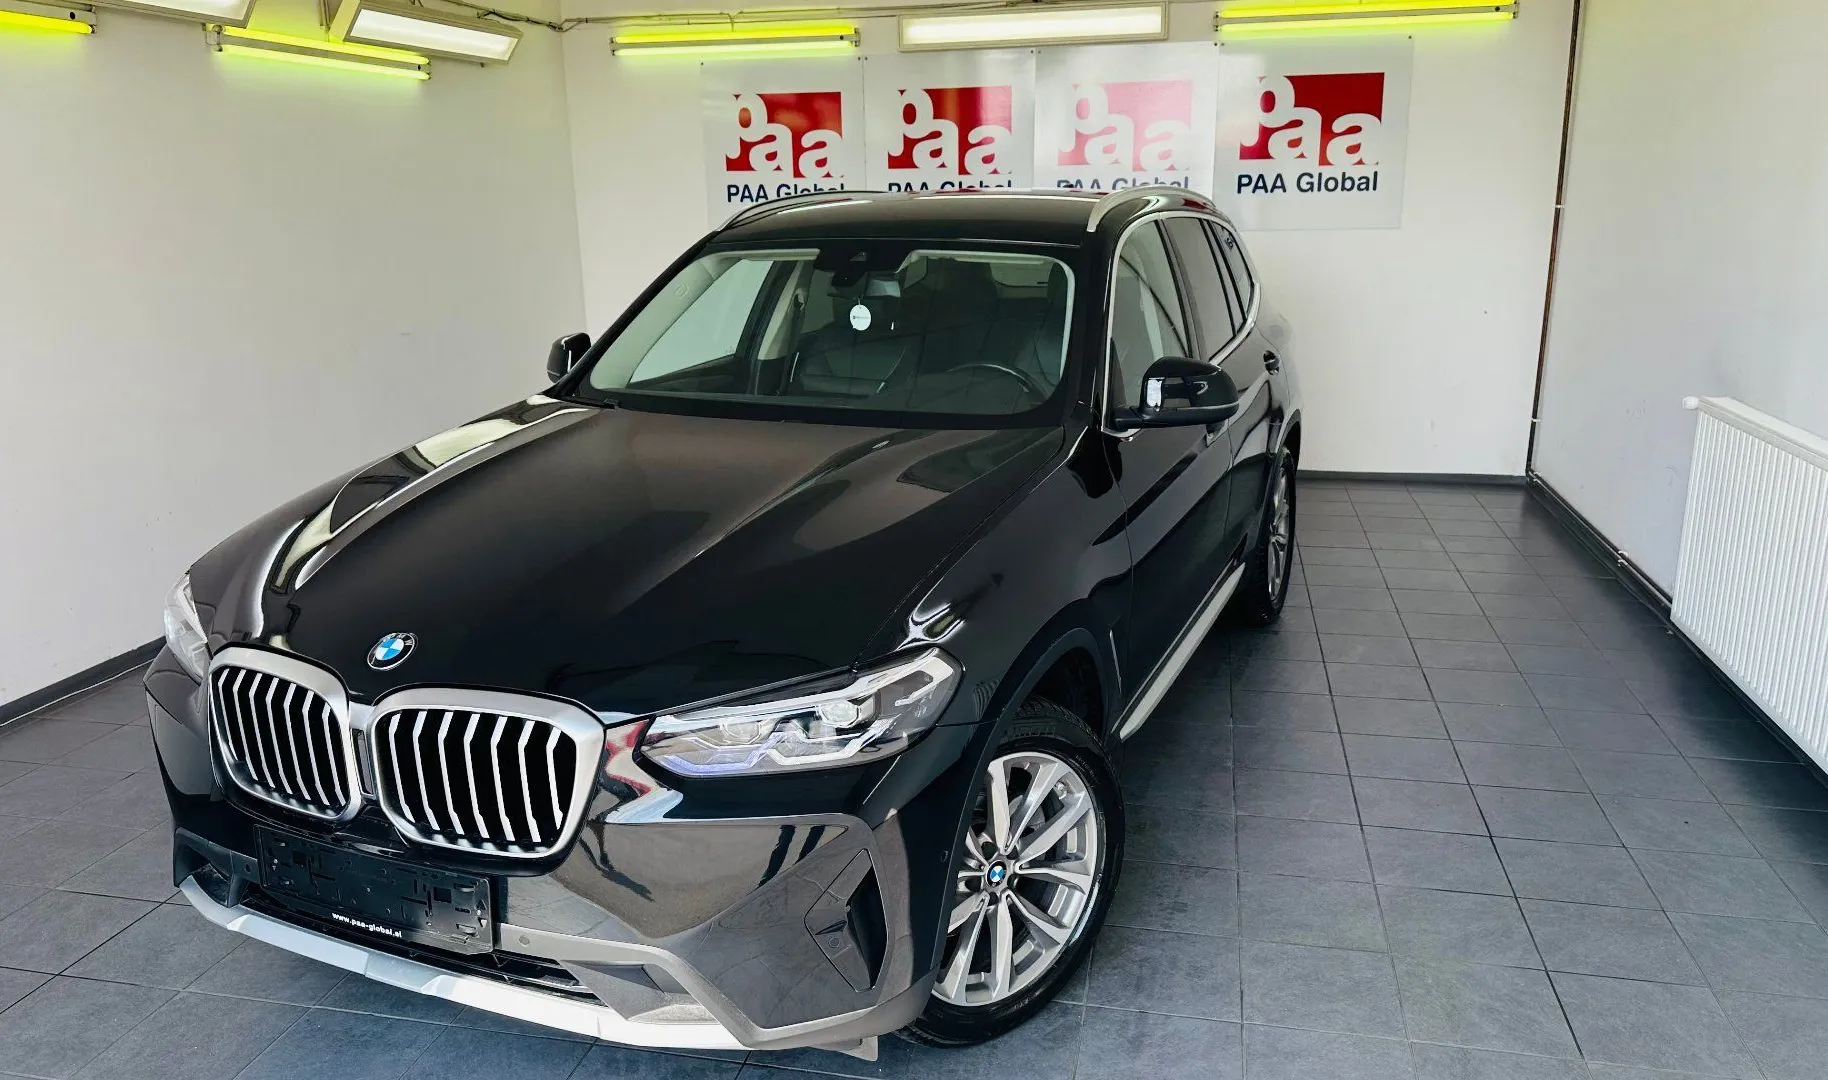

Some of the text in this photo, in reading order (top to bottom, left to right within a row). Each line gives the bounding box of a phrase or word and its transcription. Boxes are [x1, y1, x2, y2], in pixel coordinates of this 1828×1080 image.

[1237, 171, 1378, 194] PAA Global
[727, 184, 769, 203] PAA
